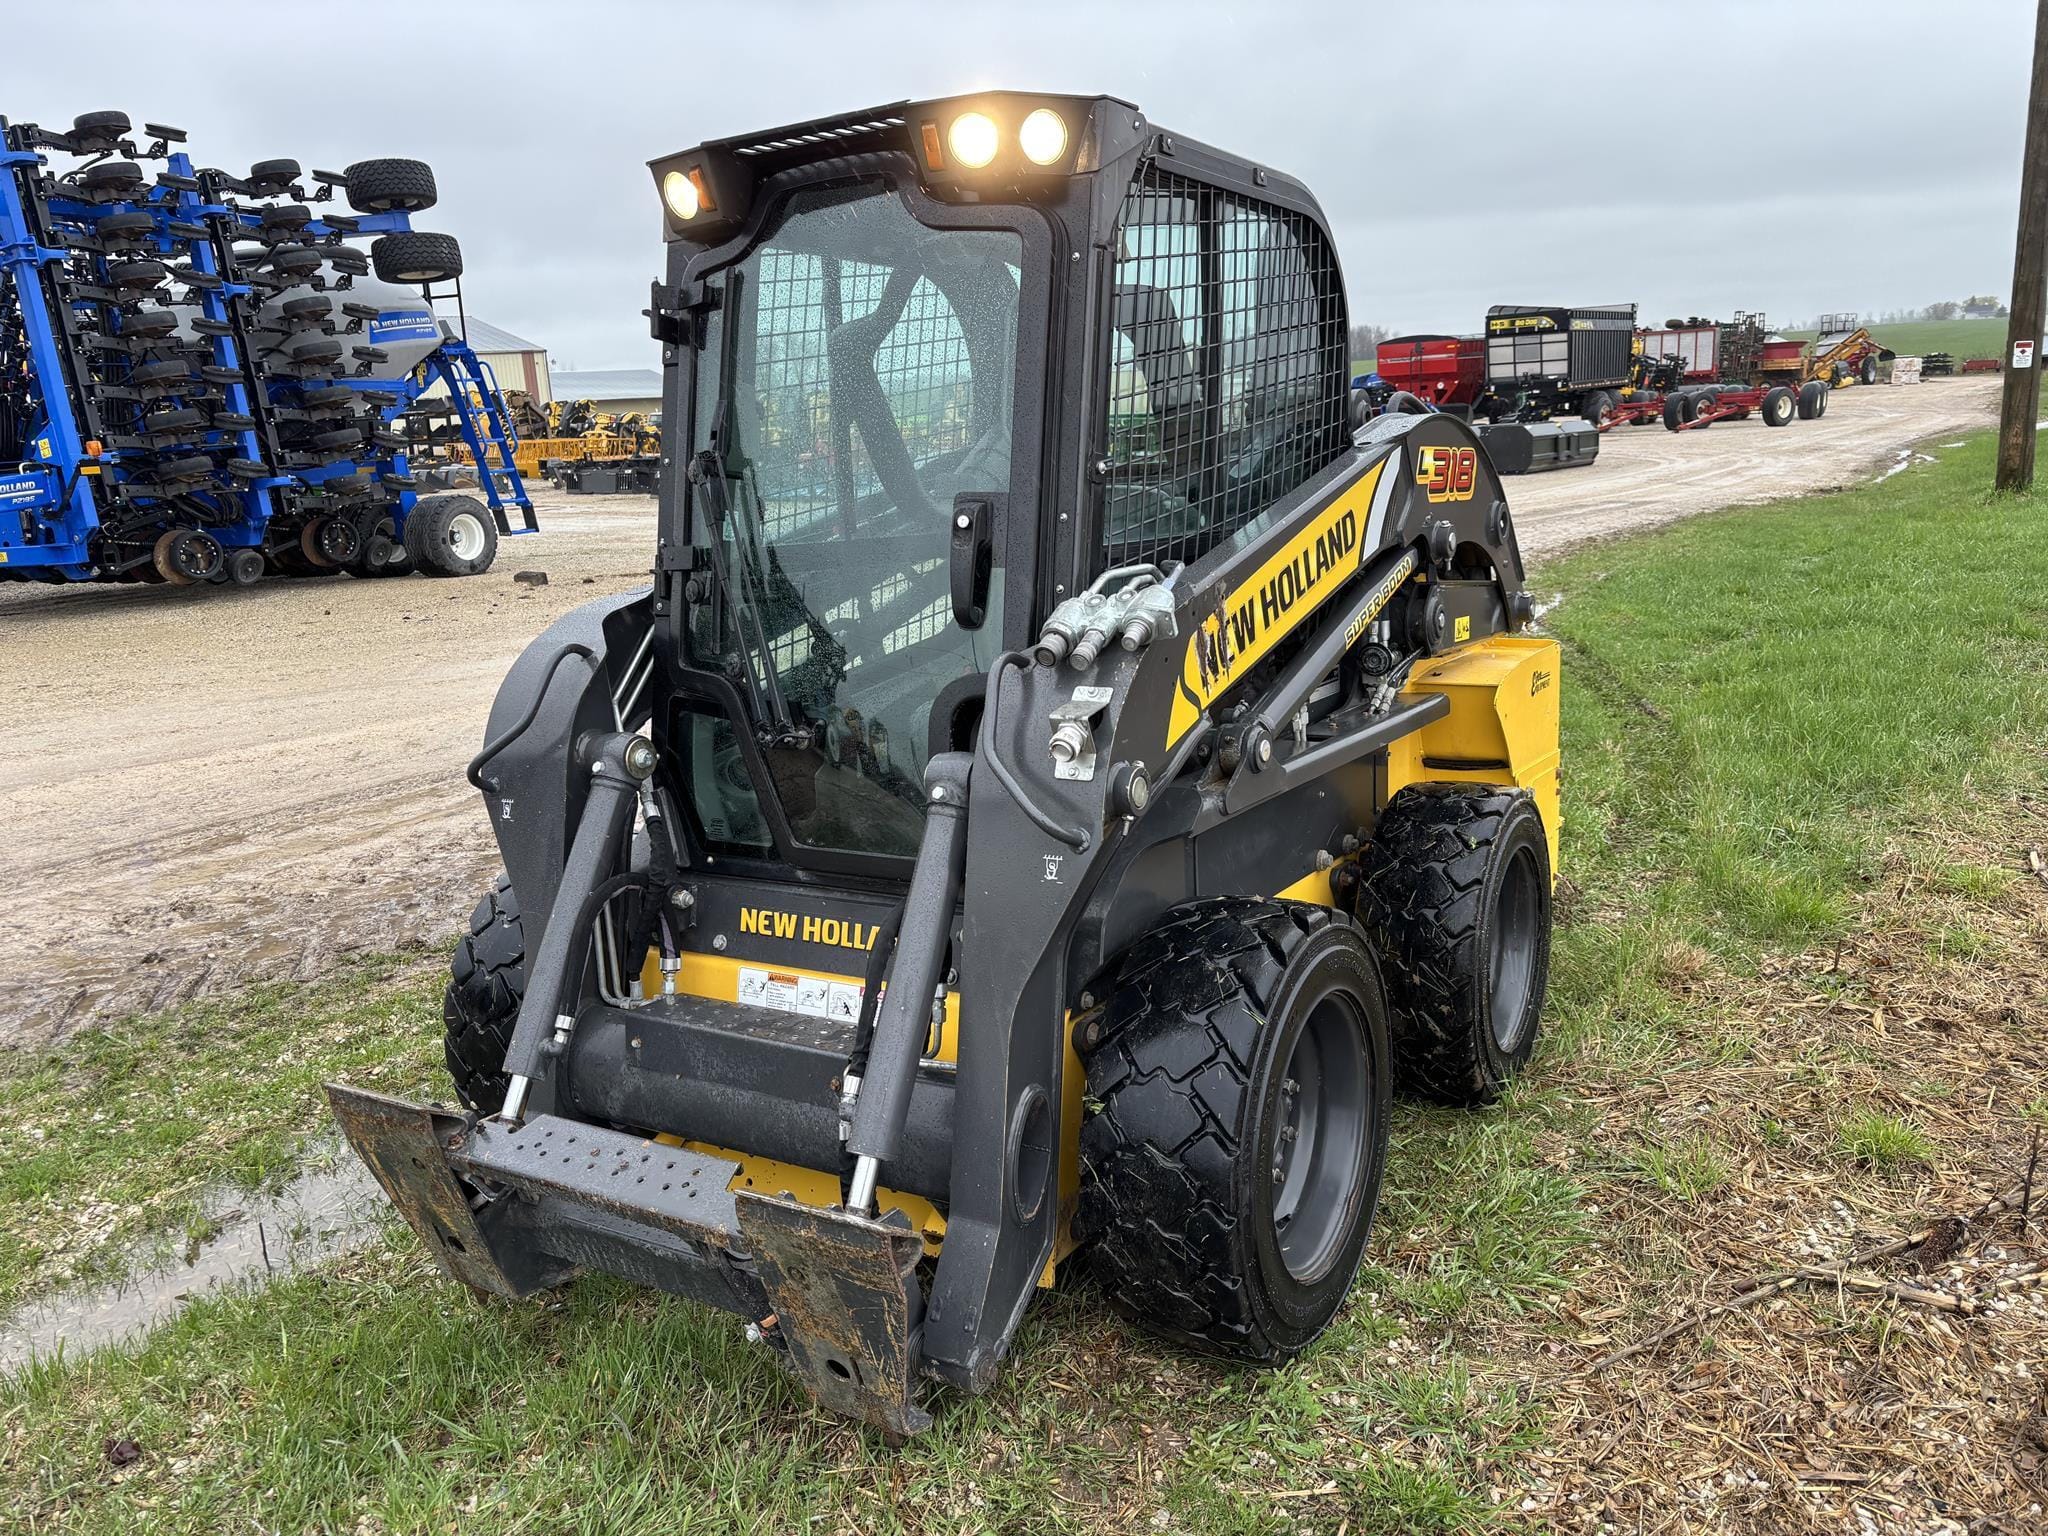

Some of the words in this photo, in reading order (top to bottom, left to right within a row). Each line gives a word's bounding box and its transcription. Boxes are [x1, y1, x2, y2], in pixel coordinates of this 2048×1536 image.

[399, 317, 430, 326] HOLLAND
[1416, 446, 1476, 503] L318
[1196, 596, 1256, 690] NEW
[1260, 509, 1357, 630] HOLLAND
[1344, 592, 1384, 650] SUPER
[1380, 556, 1412, 605] BOOM
[740, 907, 797, 939] NEW
